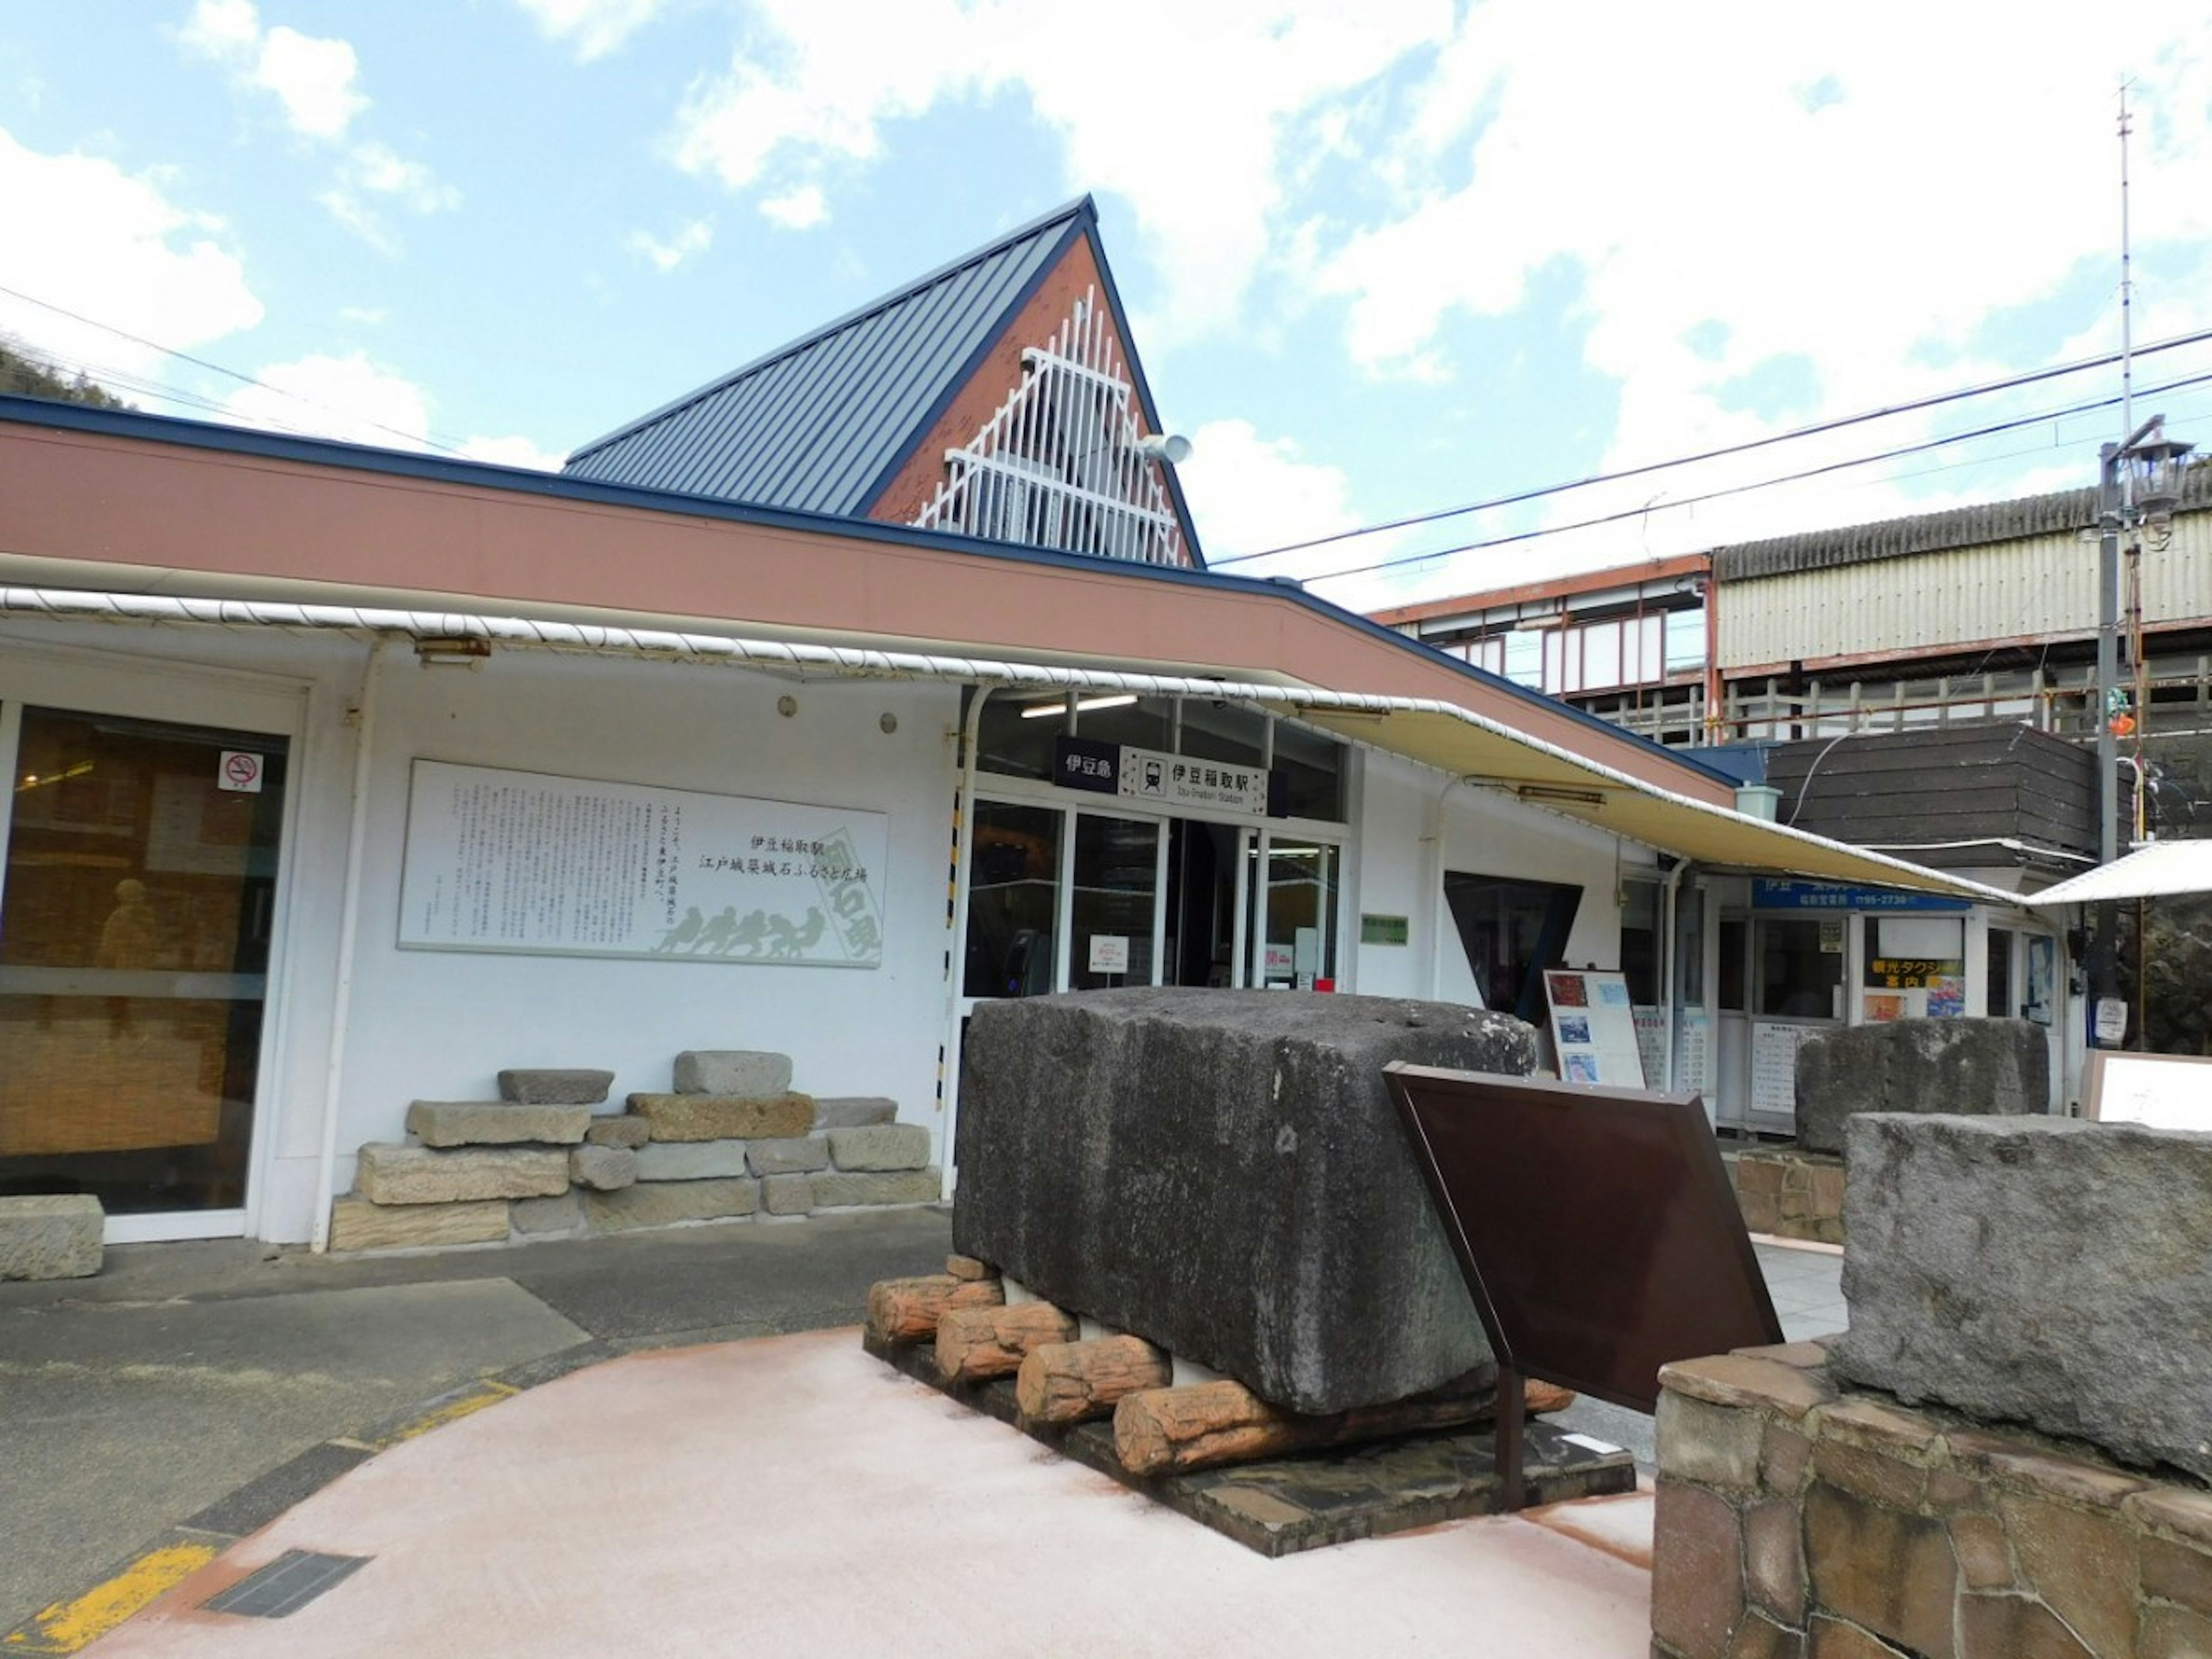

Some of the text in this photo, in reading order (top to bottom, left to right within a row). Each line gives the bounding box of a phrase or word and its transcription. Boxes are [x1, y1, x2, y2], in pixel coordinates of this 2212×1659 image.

[1066, 753, 1111, 778] 伊豆急
[1172, 763, 1249, 792] 伊豆稲取駅
[1218, 791, 1244, 805] Station
[751, 835, 825, 856] 伊豆稲取駅
